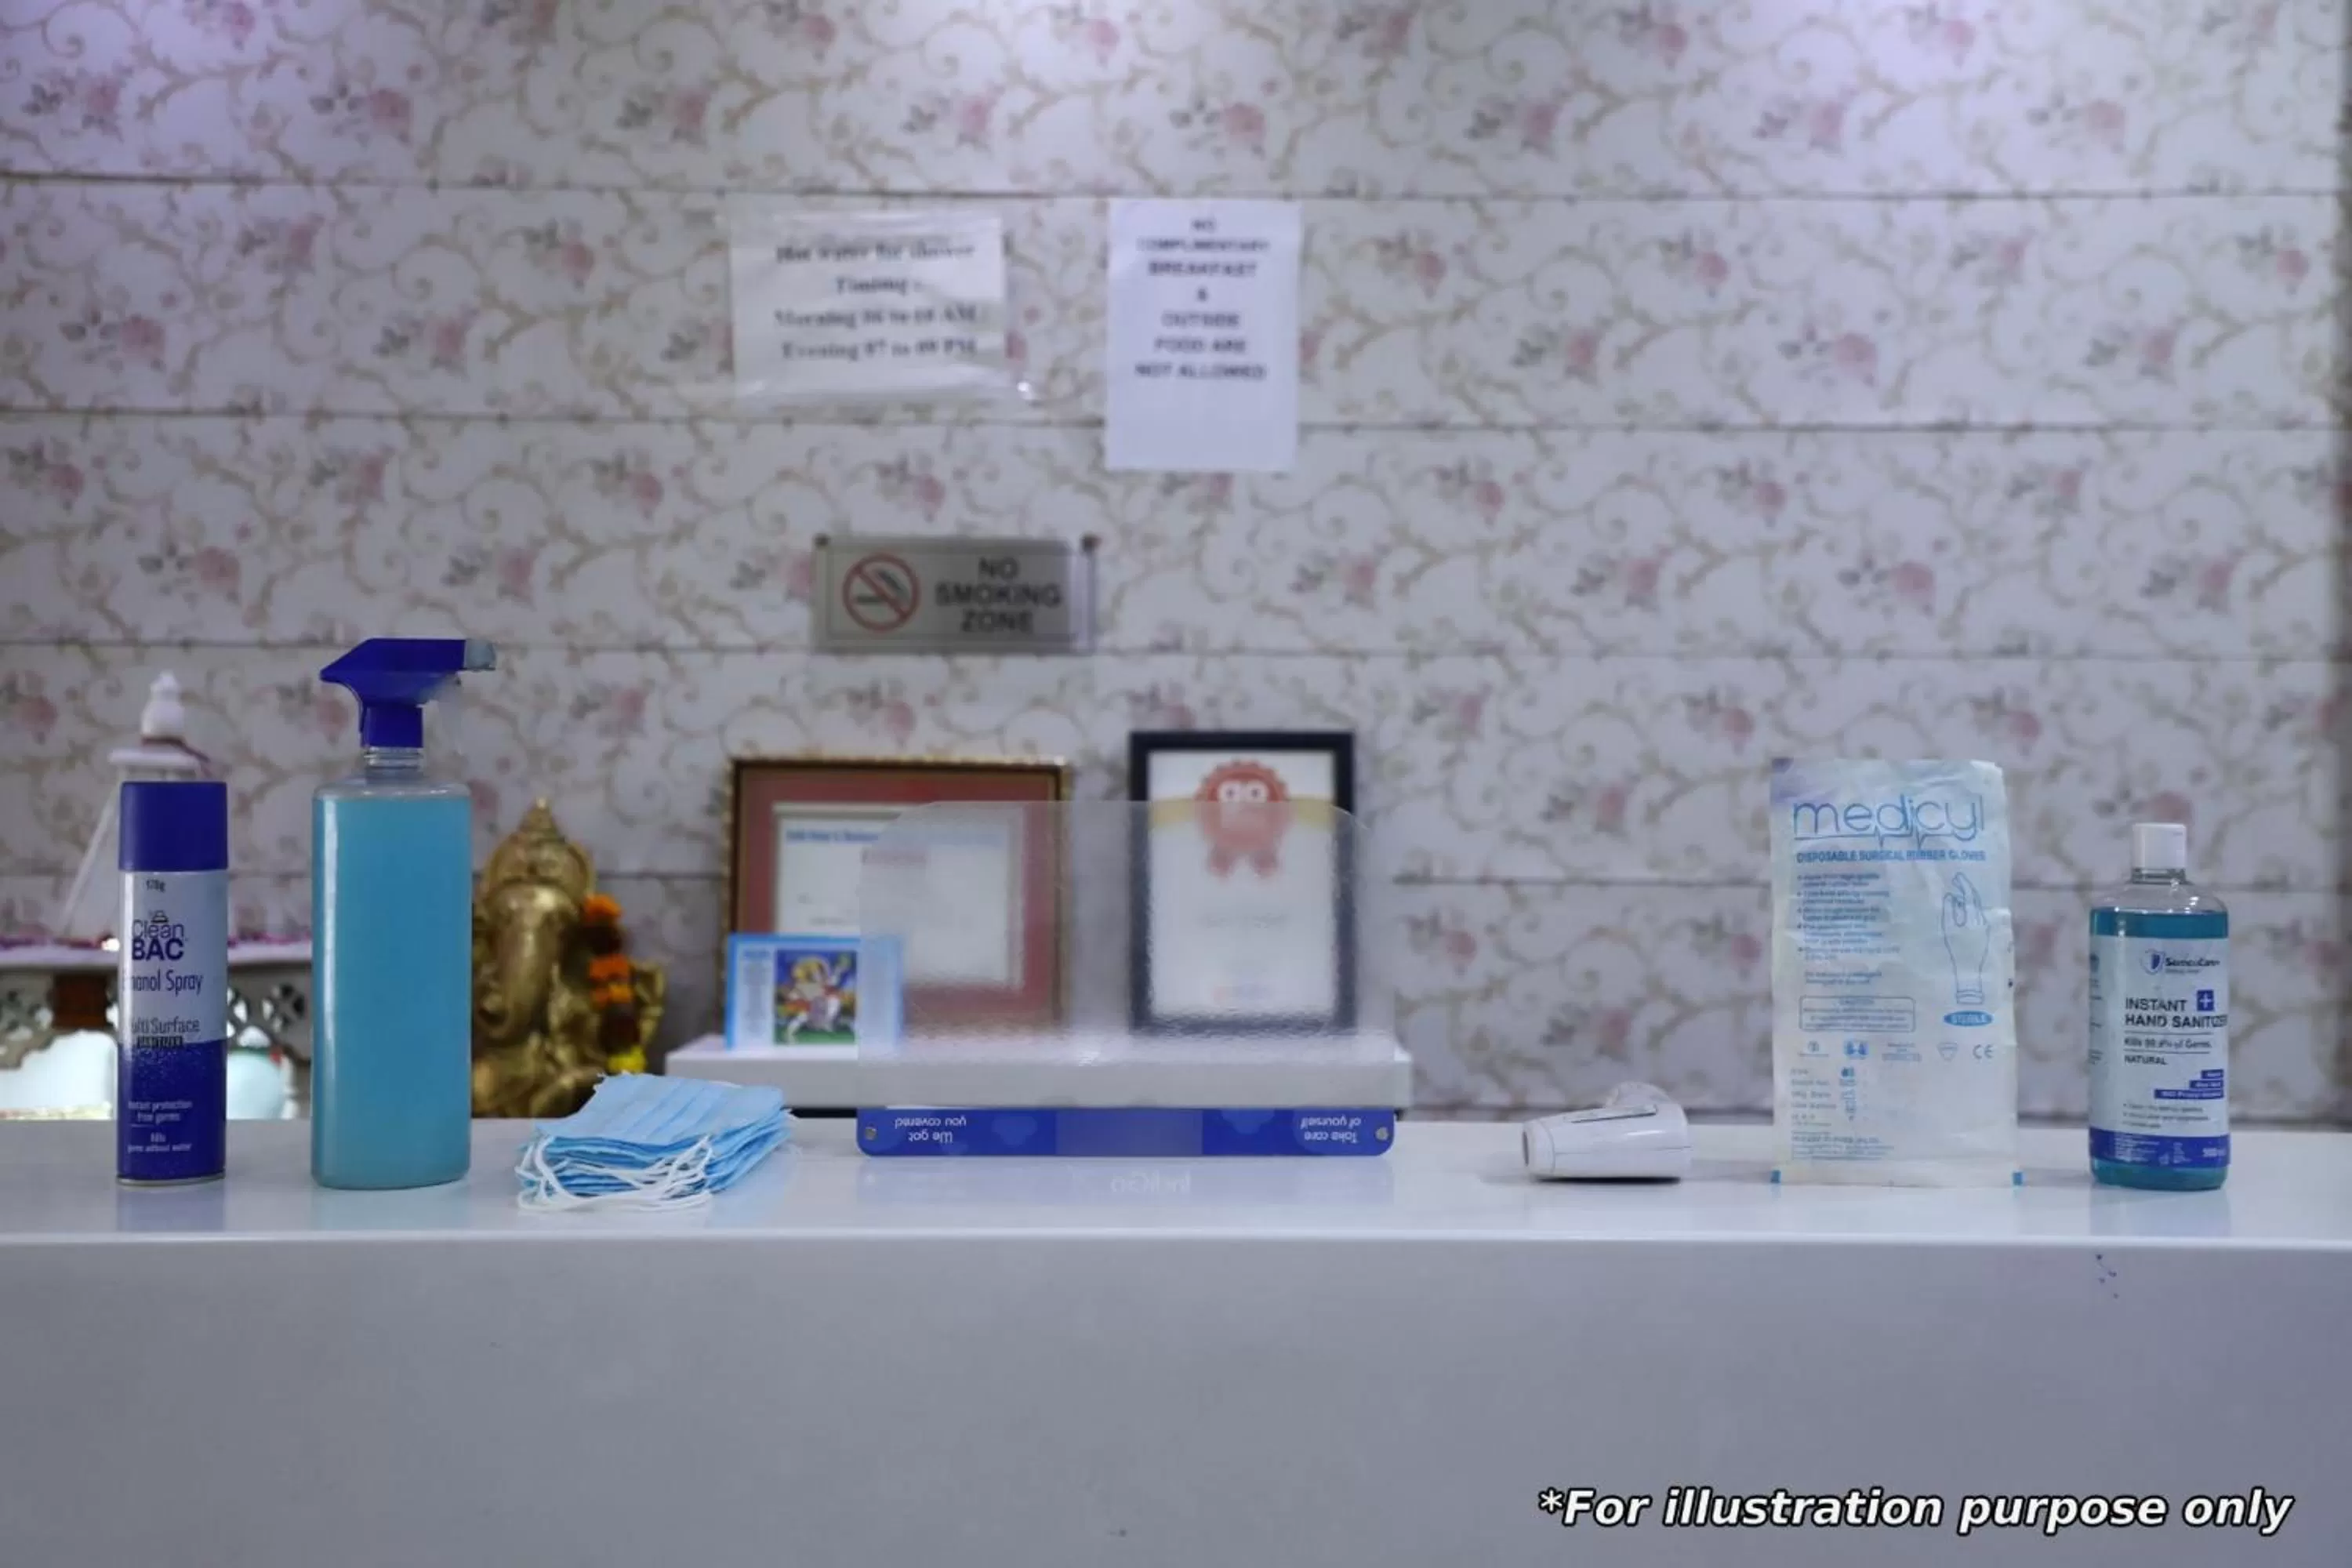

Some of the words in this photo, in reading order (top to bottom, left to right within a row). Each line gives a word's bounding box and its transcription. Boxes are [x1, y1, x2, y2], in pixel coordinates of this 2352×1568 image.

[1148, 260, 1257, 275] BREAKFAST
[774, 308, 857, 329] Morning
[1161, 312, 1240, 328] OUTSIDE
[782, 341, 858, 361] Evening
[1154, 336, 1203, 353] FOOD
[1213, 336, 1246, 353] ARE
[1135, 362, 1172, 379] NOT
[1178, 363, 1267, 379] ALLOWED
[978, 557, 1020, 579] NO
[935, 583, 1062, 608] SMOKING
[961, 611, 1033, 633] ZONE
[1797, 850, 1857, 863] DISPOSABLE
[1860, 850, 1905, 862] SURGICAL
[1906, 850, 1945, 861] RUBBER
[1948, 850, 1986, 861] GLOVES
[132, 919, 185, 938] Clean
[132, 938, 184, 961] BAC
[166, 968, 204, 997] Spray
[2125, 996, 2187, 1013] INSTANT
[151, 1015, 201, 1034] Surface
[2125, 1014, 2168, 1028] HAND
[2124, 1054, 2167, 1065] NATURAL
[895, 1117, 942, 1129] covered
[945, 1114, 967, 1127] you
[1301, 1114, 1348, 1130] yourself
[1348, 1116, 1362, 1129] of
[908, 1129, 929, 1142] got
[932, 1131, 953, 1144] We
[1304, 1131, 1330, 1142] care
[1330, 1131, 1357, 1144] Take
